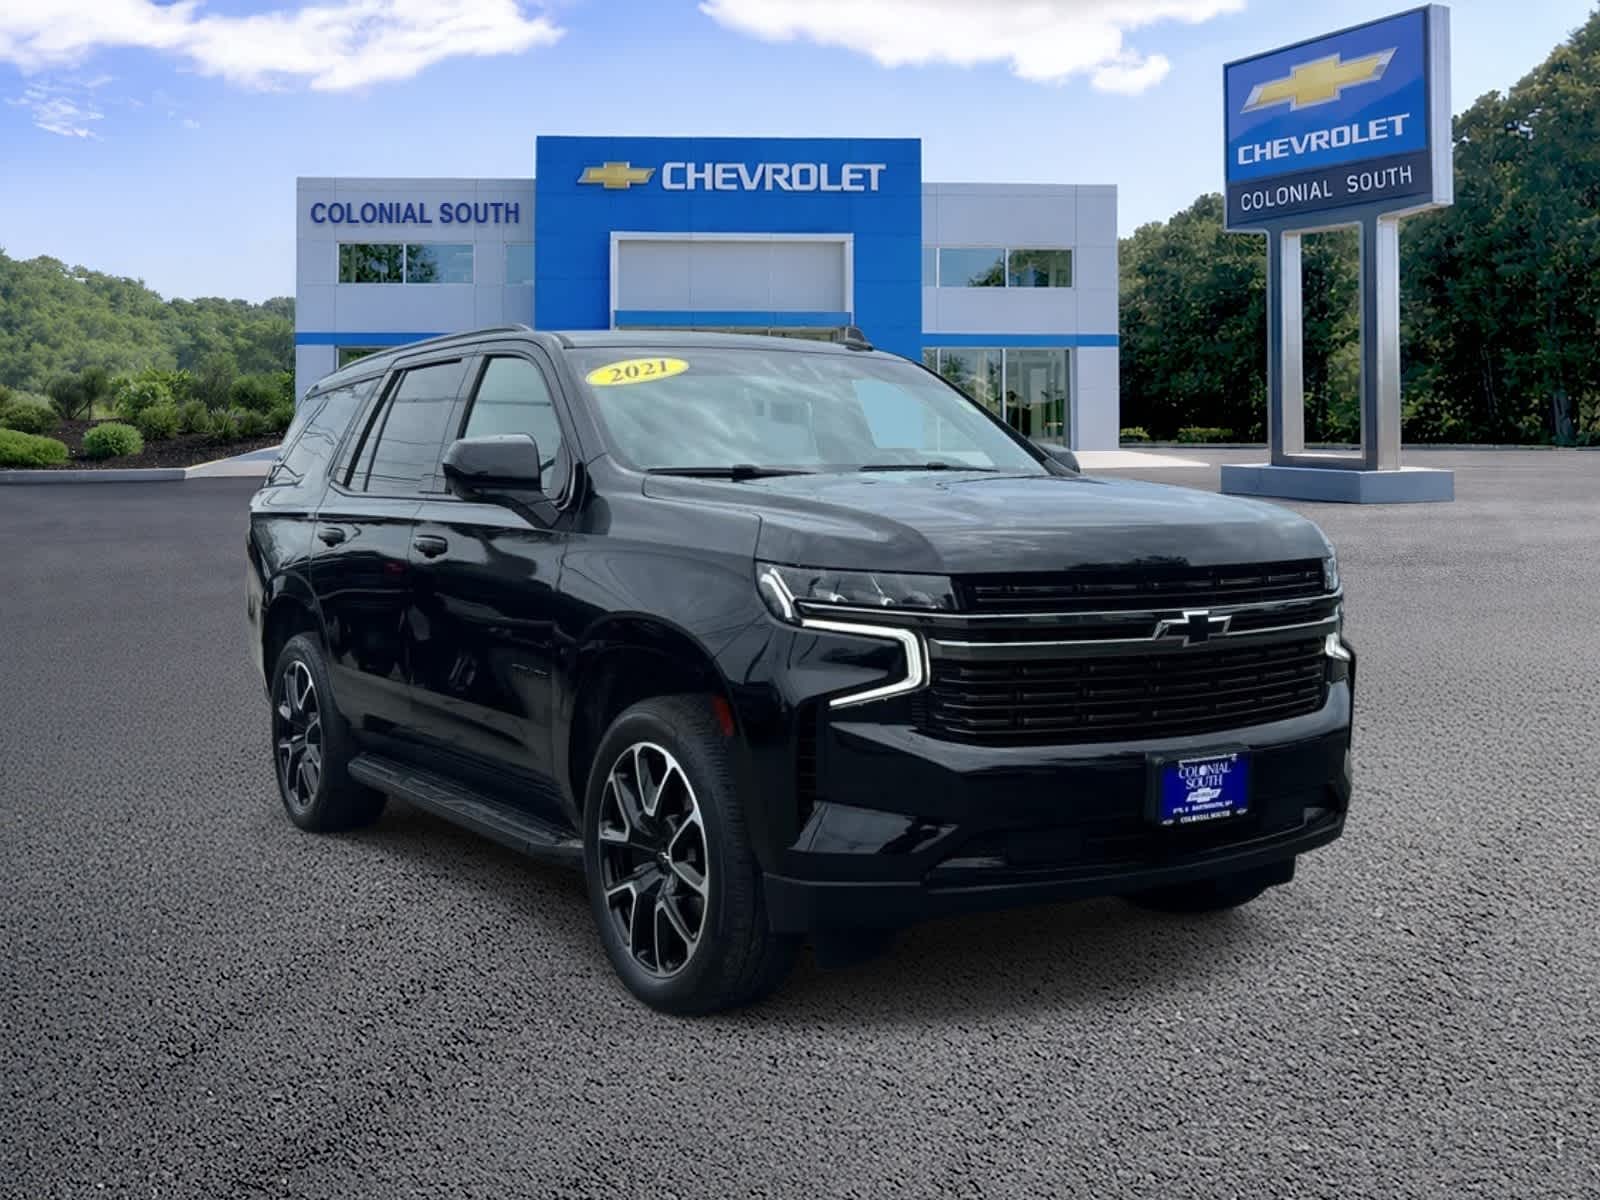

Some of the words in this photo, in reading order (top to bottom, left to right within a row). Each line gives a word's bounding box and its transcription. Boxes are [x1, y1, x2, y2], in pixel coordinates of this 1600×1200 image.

[1238, 113, 1410, 165] CHEVROLET
[661, 162, 887, 192] CHEVROLET
[1241, 179, 1333, 211] COLONIAL
[1346, 165, 1412, 194] SOUTH
[310, 202, 432, 224] COLONIAL
[439, 202, 520, 224] SOUTH
[608, 360, 667, 382] 2021
[1178, 761, 1232, 779] COLNIAL
[1186, 774, 1223, 790] SOUTH
